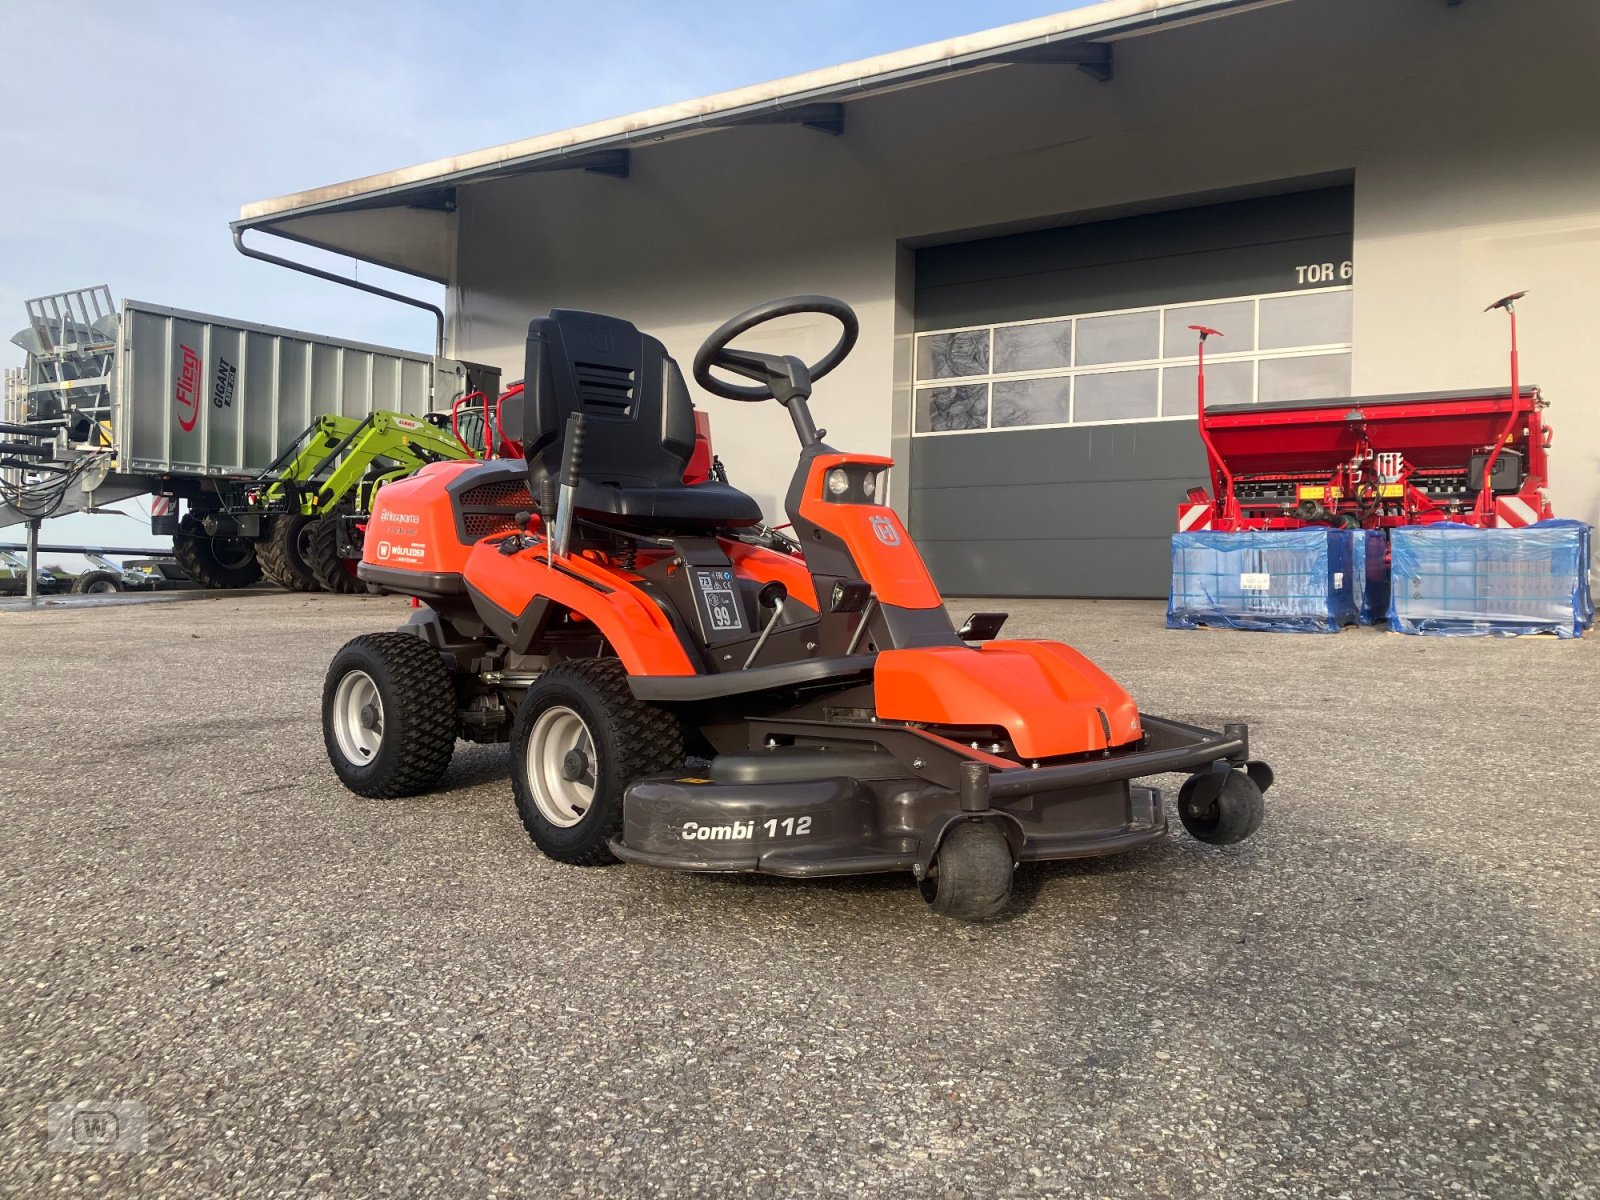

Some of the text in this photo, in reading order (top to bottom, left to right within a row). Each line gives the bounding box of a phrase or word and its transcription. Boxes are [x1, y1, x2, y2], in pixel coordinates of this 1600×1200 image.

[1295, 260, 1353, 284] TOR 6
[176, 344, 199, 406] Fliegl
[213, 356, 229, 409] GIGANT
[714, 606, 731, 626] 99
[682, 816, 812, 840] Combi 112
